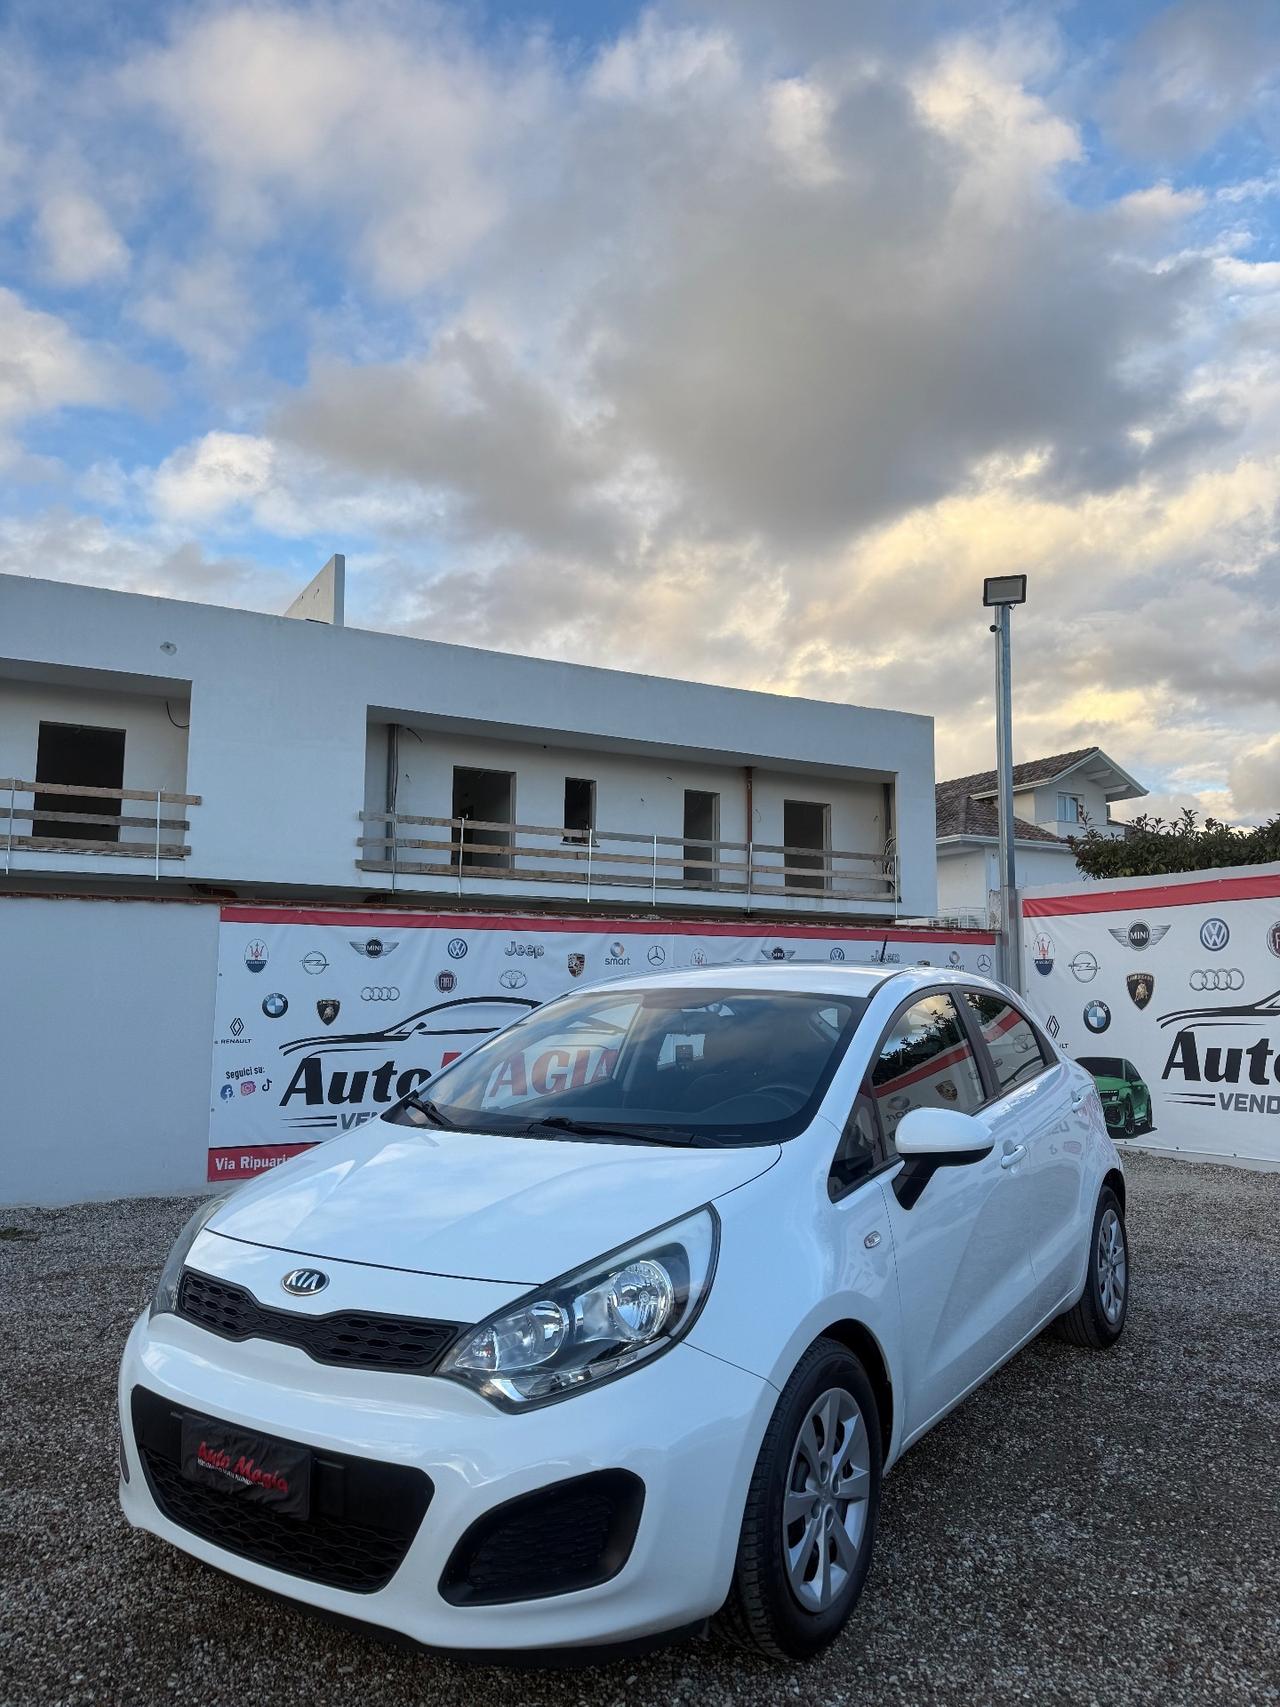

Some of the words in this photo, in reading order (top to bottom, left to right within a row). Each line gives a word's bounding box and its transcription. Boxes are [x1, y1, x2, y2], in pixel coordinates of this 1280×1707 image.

[1129, 931, 1149, 940] MINI
[504, 941, 545, 959] Jeep
[604, 956, 631, 966] smart
[440, 977, 453, 988] FIAT
[1161, 1031, 1280, 1086] Aut
[225, 1066, 253, 1080] Seguici
[215, 1158, 236, 1171] Via
[198, 1441, 231, 1469] Auto
[232, 1456, 289, 1493] Magia
